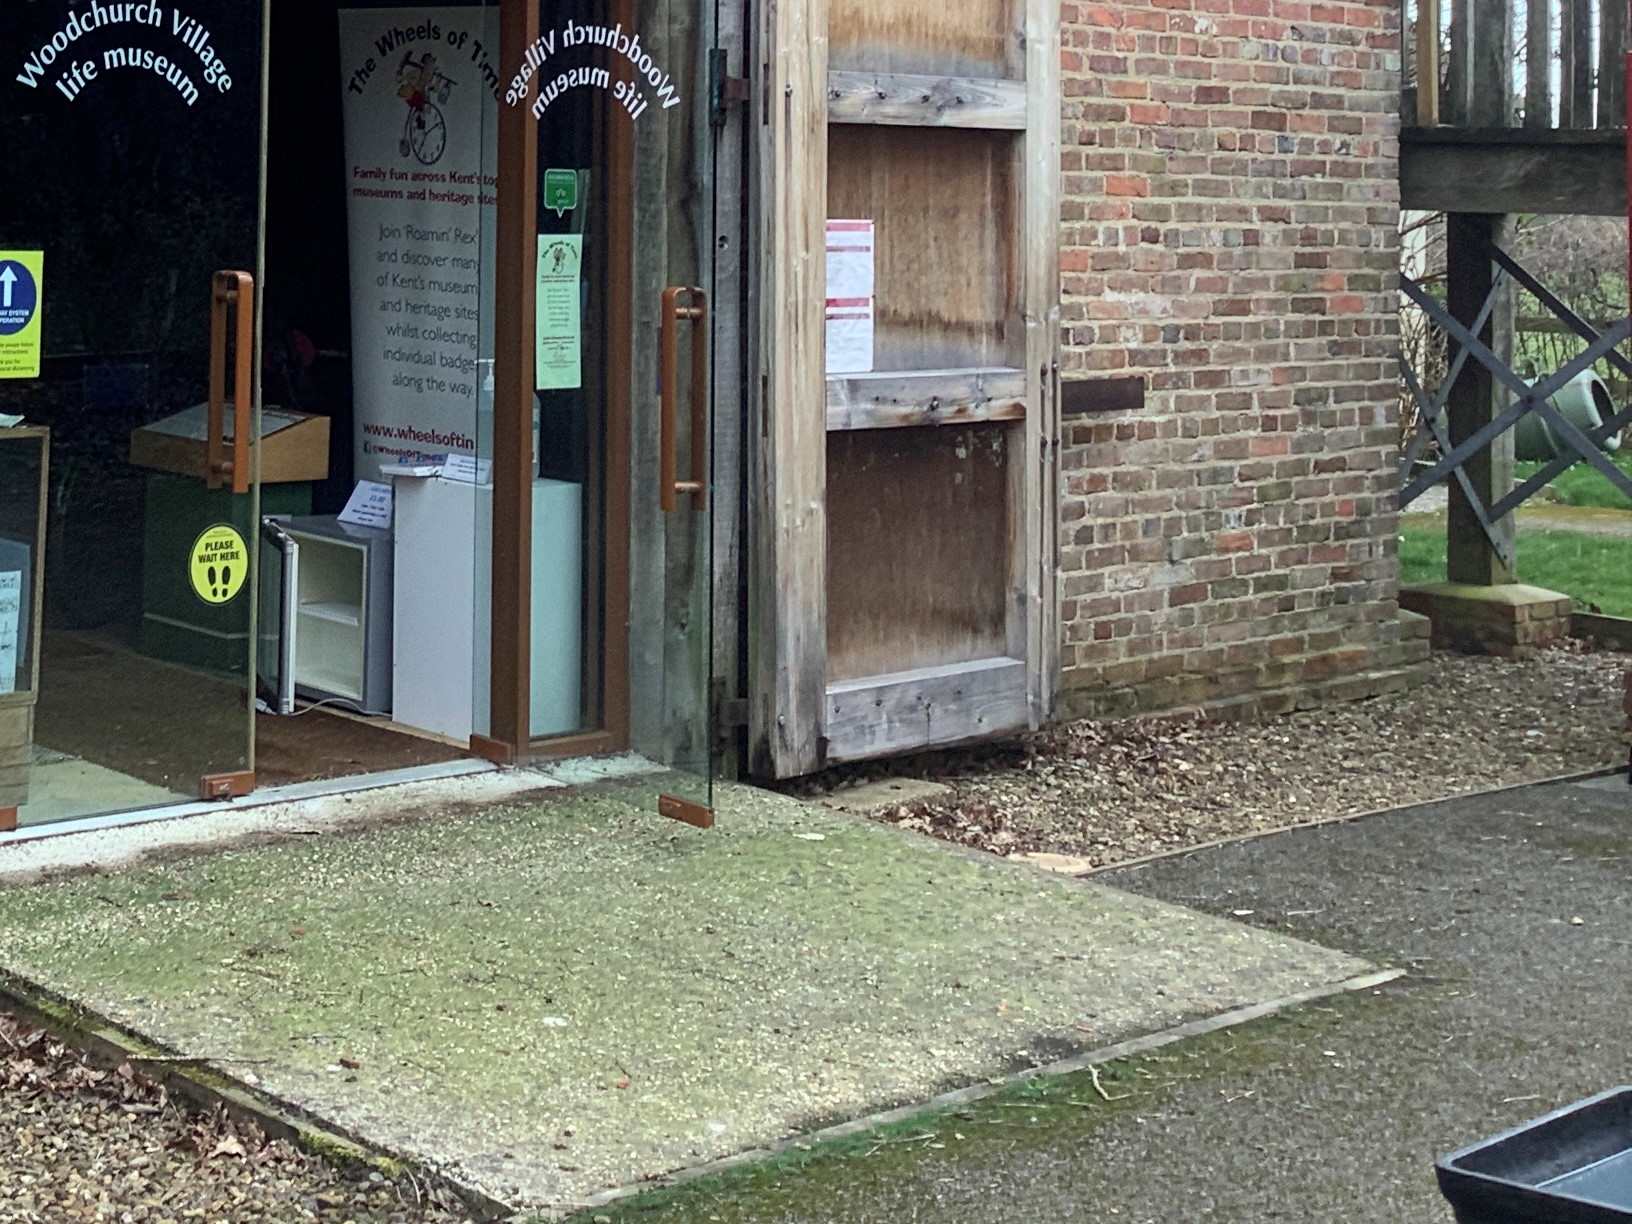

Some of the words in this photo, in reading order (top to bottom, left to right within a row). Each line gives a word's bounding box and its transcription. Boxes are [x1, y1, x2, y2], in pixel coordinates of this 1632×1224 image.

[172, 8, 233, 94] Village
[348, 57, 377, 95] The
[374, 19, 441, 58] Wheels
[447, 31, 468, 50] of
[55, 60, 98, 102] life
[103, 47, 199, 106] museum
[353, 166, 387, 182] Family
[389, 168, 408, 181] fun
[411, 171, 446, 183] across
[449, 171, 481, 185] Kent's
[353, 187, 404, 200] museums
[407, 189, 426, 201] and
[429, 189, 474, 206] heritage
[379, 224, 401, 241] Join
[376, 249, 398, 263] and
[401, 249, 448, 267] discover
[376, 272, 390, 287] of
[392, 274, 425, 291] Kent's
[428, 281, 478, 294] museum
[379, 299, 402, 312] and
[405, 299, 451, 321] heritage
[455, 306, 479, 321] sites
[386, 322, 418, 338] whilst
[422, 327, 477, 350] collecting
[383, 347, 436, 366] individual
[440, 353, 477, 375] badge
[392, 372, 423, 394] along
[426, 376, 446, 391] the
[205, 540, 234, 551] PLEASE
[198, 553, 217, 564] WAIT
[220, 551, 240, 561] HERE
